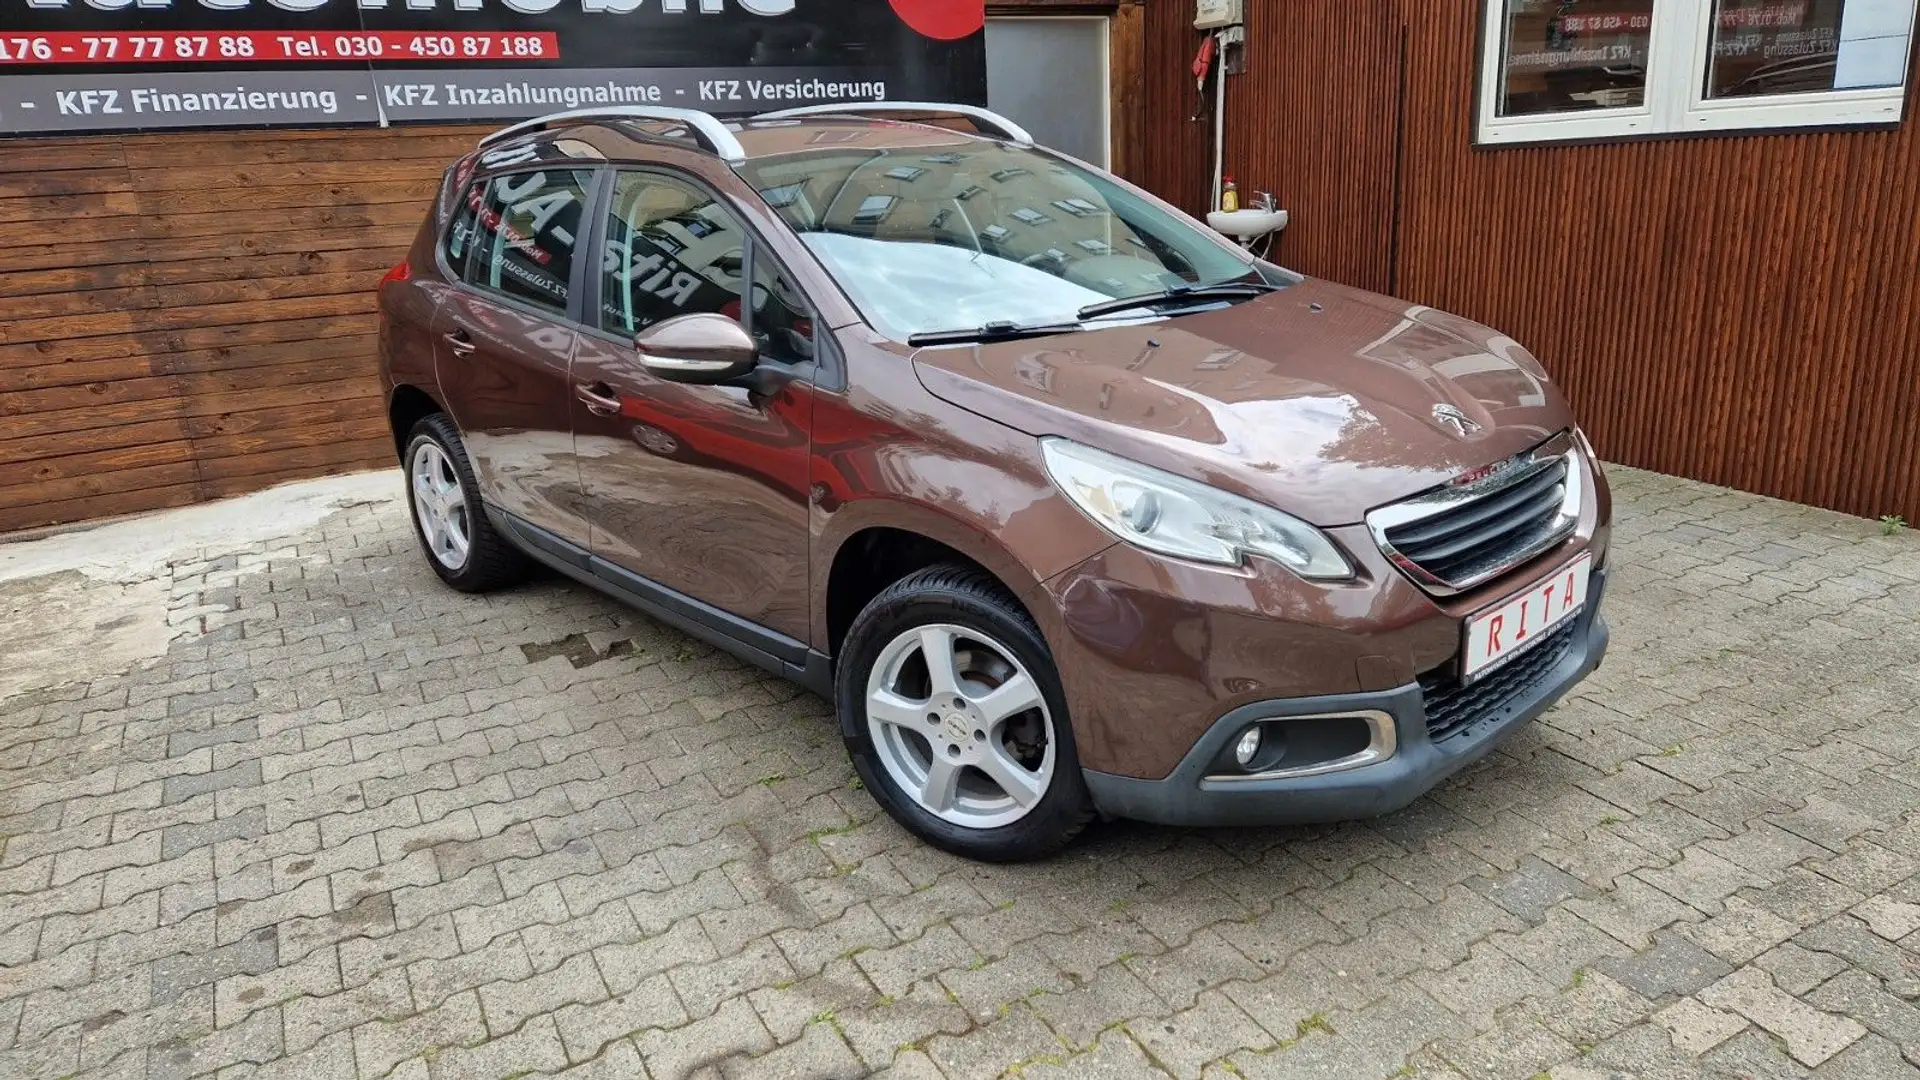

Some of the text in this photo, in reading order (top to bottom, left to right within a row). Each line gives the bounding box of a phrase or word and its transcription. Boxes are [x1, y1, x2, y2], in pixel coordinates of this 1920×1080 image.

[81, 37, 118, 58] 77
[128, 37, 164, 58] 77
[174, 36, 209, 57] 87
[218, 36, 254, 57] 88
[276, 36, 328, 56] Tel.
[334, 36, 383, 56] 030
[409, 36, 456, 56] 450
[462, 36, 491, 56] 87
[500, 37, 543, 56] 188
[56, 90, 123, 115] KFZ
[130, 87, 338, 114] Finanzierung
[383, 84, 439, 106] KFZ
[445, 81, 661, 108] Inzahlungnahme
[699, 80, 741, 100] KFZ
[746, 78, 885, 100] Versicherung
